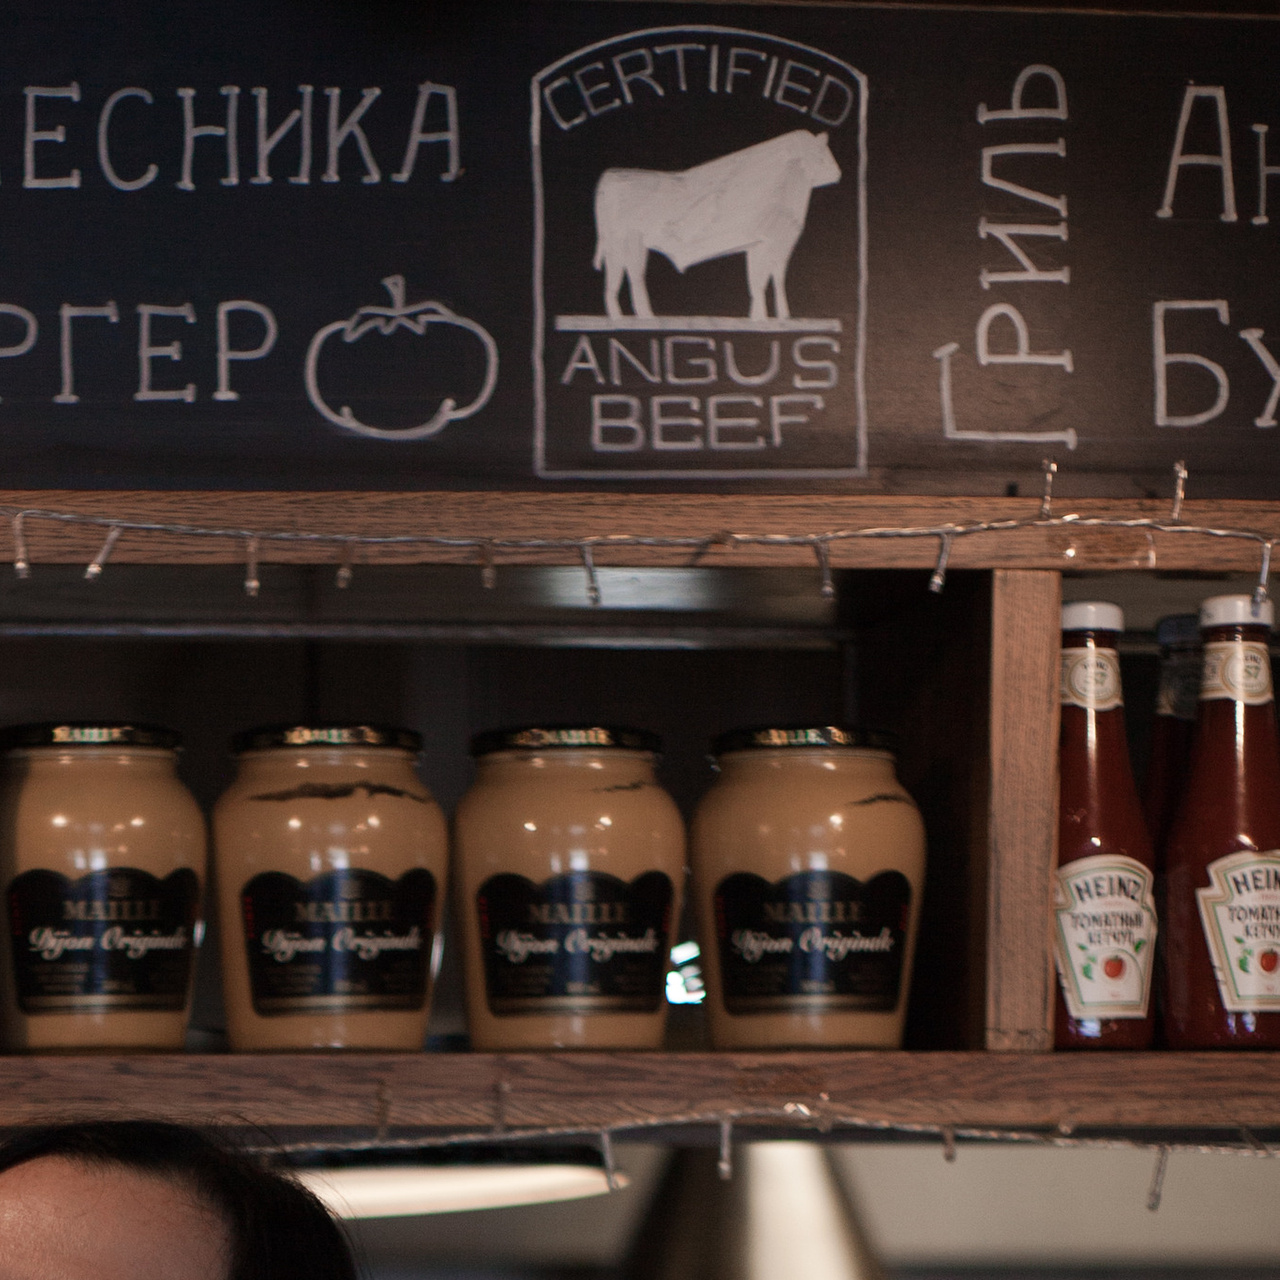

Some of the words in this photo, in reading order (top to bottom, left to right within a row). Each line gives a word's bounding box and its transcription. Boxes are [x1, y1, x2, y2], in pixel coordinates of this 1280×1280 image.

[544, 43, 853, 131] CERTIFIED
[933, 63, 1077, 451] ГРИЛЬ
[561, 336, 839, 389] ANGUS
[591, 393, 824, 452] BEEF
[1074, 876, 1141, 902] HEINZ
